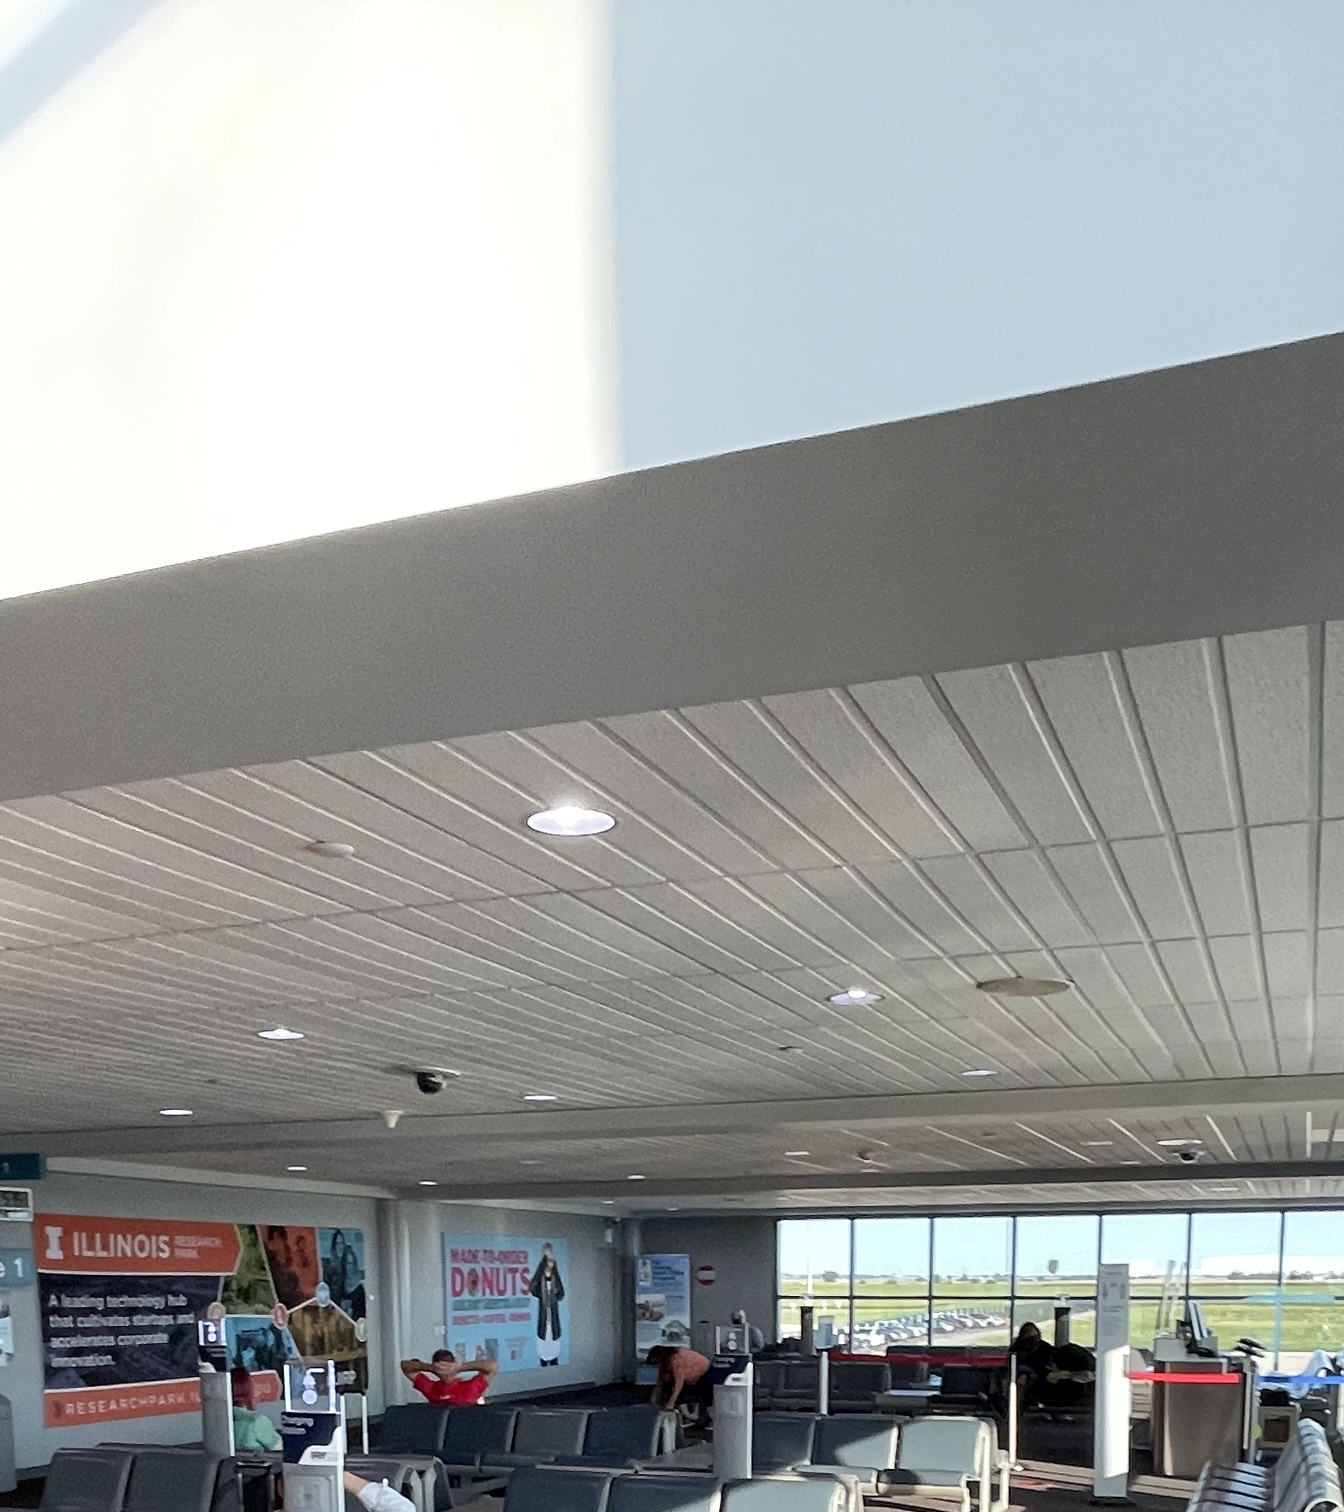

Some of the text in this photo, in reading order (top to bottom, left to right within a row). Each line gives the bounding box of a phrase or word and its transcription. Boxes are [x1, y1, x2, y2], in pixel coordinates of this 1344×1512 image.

[1, 1162, 10, 1174] 1
[72, 1231, 171, 1259] ILLINOIS
[14, 1257, 24, 1278] 1
[451, 1266, 531, 1298] DONUTS
[49, 1294, 59, 1308] A
[61, 1293, 105, 1310] leading
[49, 1312, 74, 1328] that
